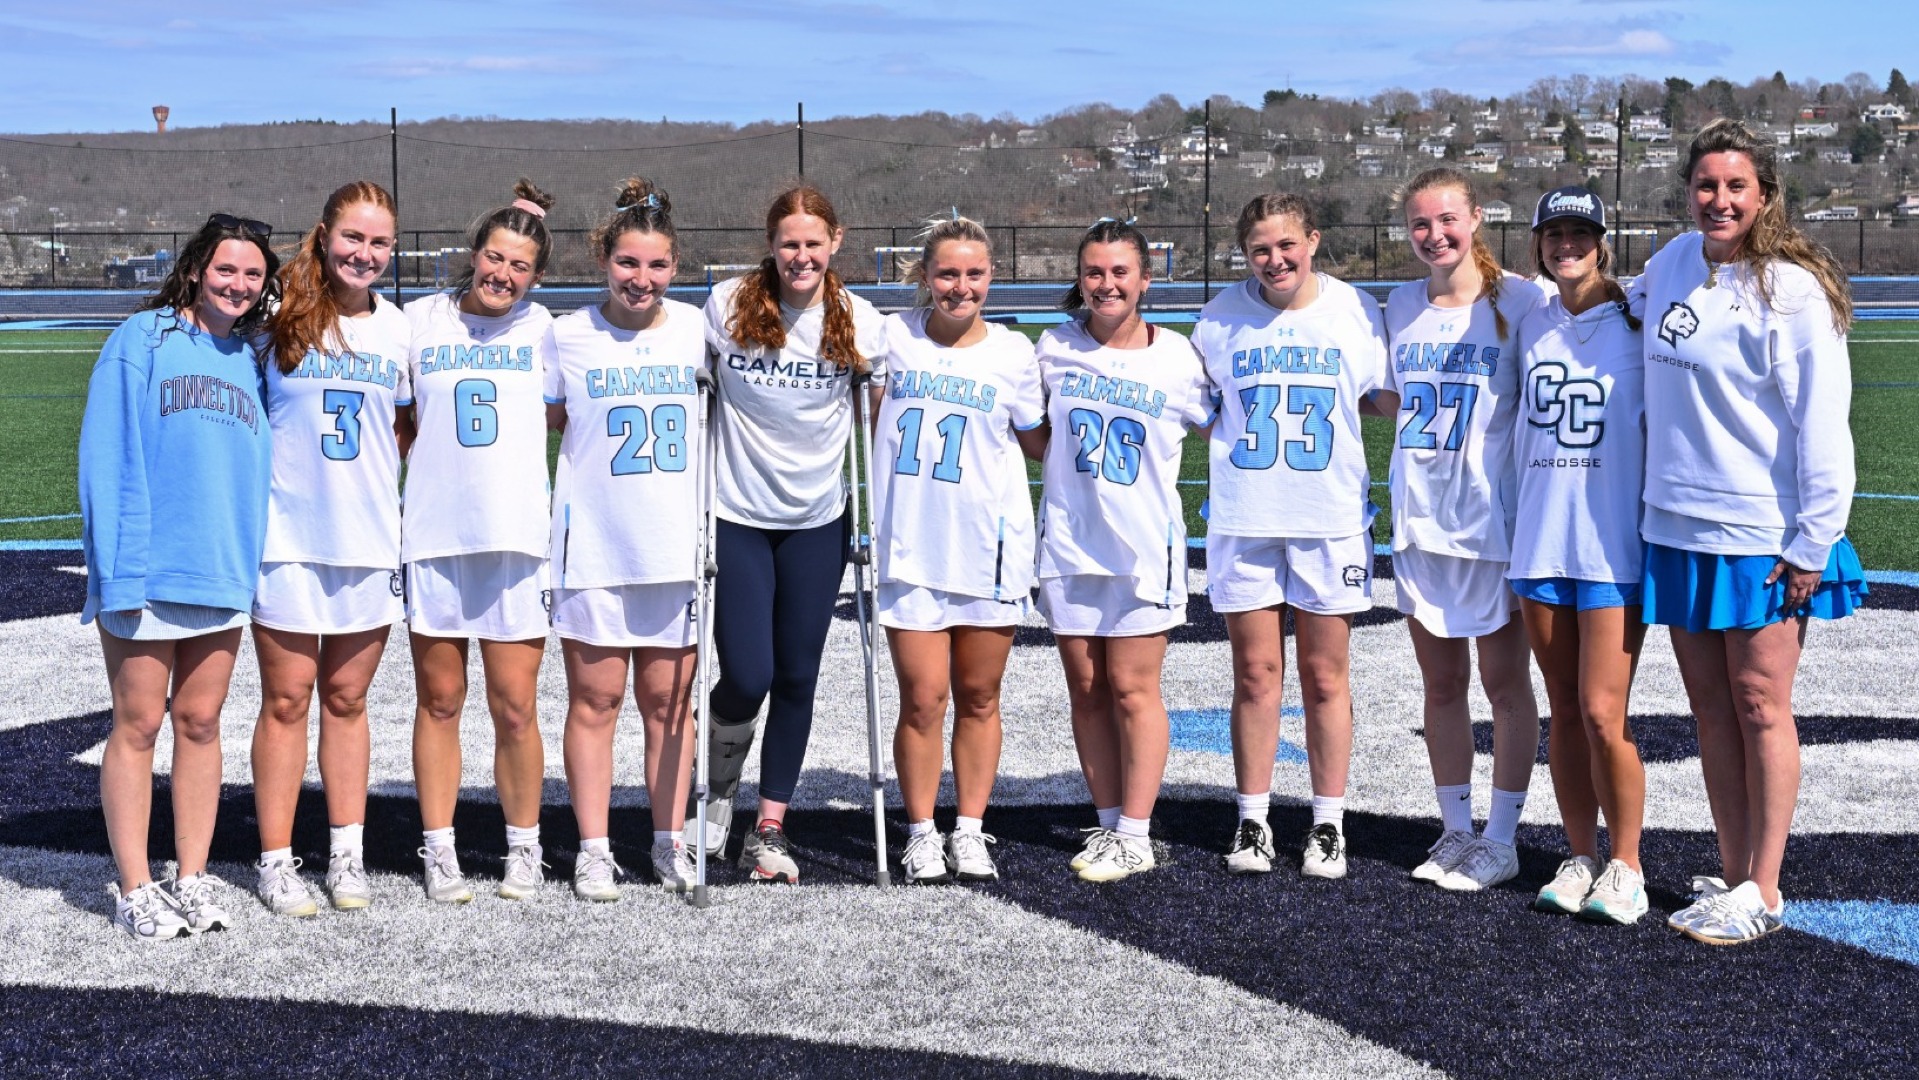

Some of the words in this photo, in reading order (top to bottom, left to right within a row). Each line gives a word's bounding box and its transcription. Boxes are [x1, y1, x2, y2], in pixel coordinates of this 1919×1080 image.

[285, 347, 398, 390] AMELS
[420, 344, 533, 375] CAMELS
[586, 364, 697, 399] CAMELS
[1232, 345, 1341, 378] CAMELS
[1396, 342, 1500, 377] CAMELS
[1648, 352, 1700, 372] LACROSSE
[743, 374, 834, 390] LACROSSE
[891, 369, 997, 413] CAMELS
[1060, 370, 1167, 419] CAMELS
[200, 414, 236, 428] COLLEGE
[321, 388, 365, 461] 3
[454, 377, 498, 448] 6
[1400, 381, 1480, 451] 27
[1527, 361, 1605, 449] CC
[606, 403, 688, 477] 28
[894, 407, 968, 484] 11
[1068, 407, 1147, 486] 26
[1228, 384, 1337, 472] 33
[1528, 457, 1602, 468] LACROSSE
